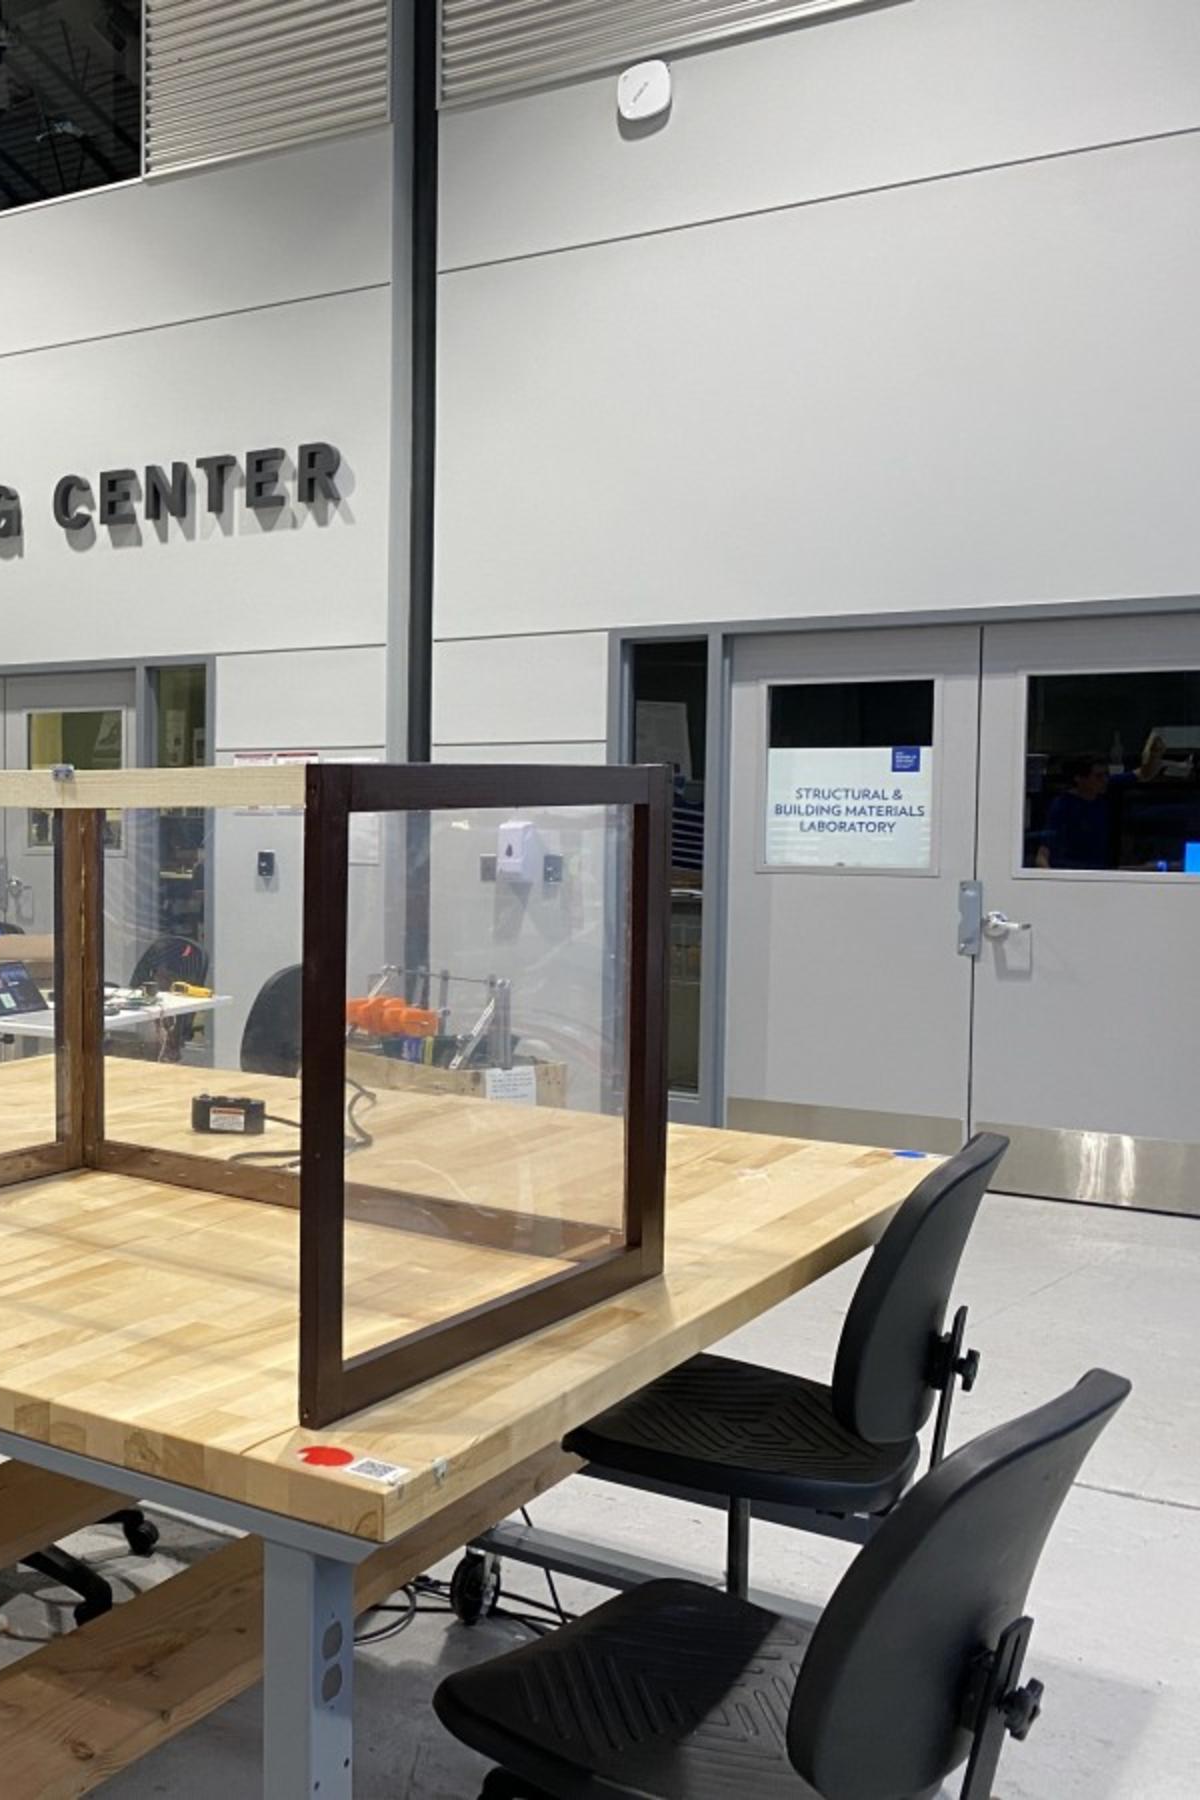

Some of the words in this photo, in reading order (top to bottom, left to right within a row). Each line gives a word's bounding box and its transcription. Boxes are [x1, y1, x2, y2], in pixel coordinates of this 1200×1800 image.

[53, 442, 341, 530] CENTER
[795, 787, 888, 800] STRUCTURAL
[892, 788, 903, 800] &
[775, 803, 841, 817] BUILDING
[845, 805, 925, 817] MATERIALS
[799, 821, 897, 833] LABORATORY
